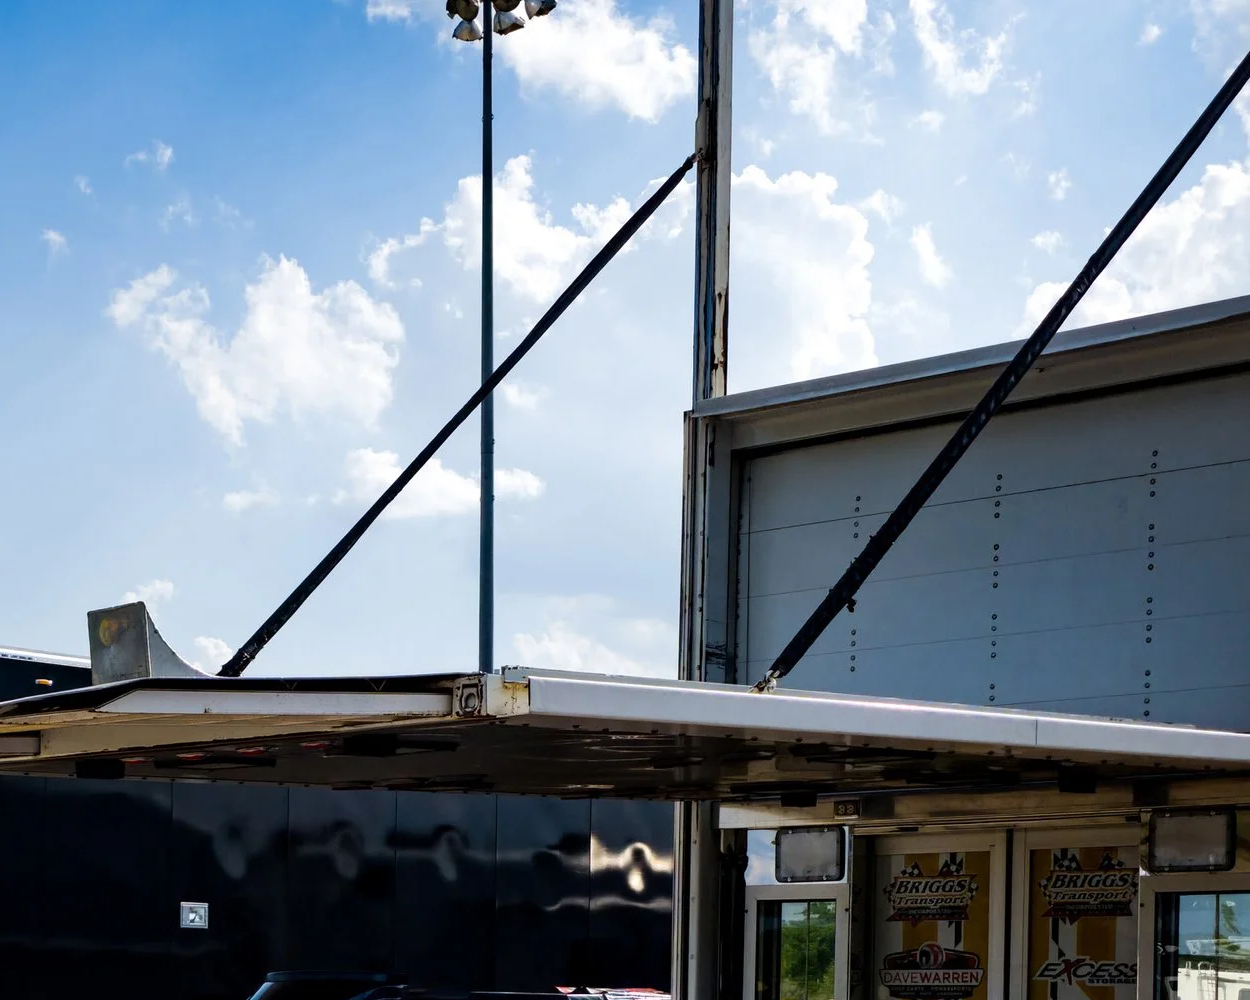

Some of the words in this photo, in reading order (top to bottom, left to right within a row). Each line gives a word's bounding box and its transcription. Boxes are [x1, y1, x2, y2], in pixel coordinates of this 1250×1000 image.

[896, 880, 967, 894] BRIGGS
[1051, 874, 1129, 888] BRIGGS
[898, 895, 966, 907] Transport
[1053, 891, 1127, 903] Transport
